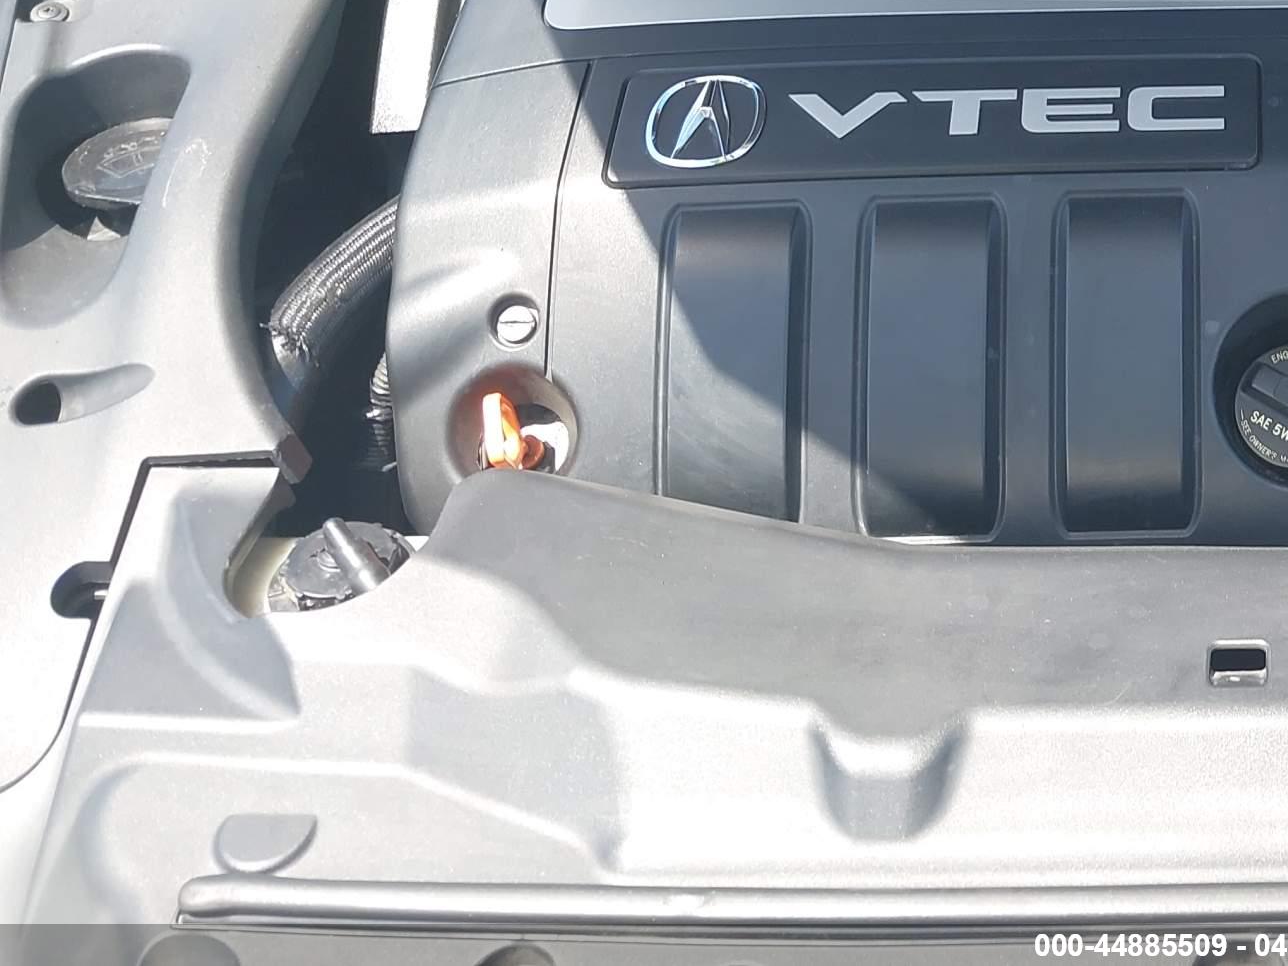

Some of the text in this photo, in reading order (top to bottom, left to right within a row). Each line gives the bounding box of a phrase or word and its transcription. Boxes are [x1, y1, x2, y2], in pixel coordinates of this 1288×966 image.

[788, 85, 1226, 139] VTEC
[1240, 419, 1252, 436] SEE
[1249, 435, 1278, 460] OWNER'S
[1250, 410, 1273, 431] SAE
